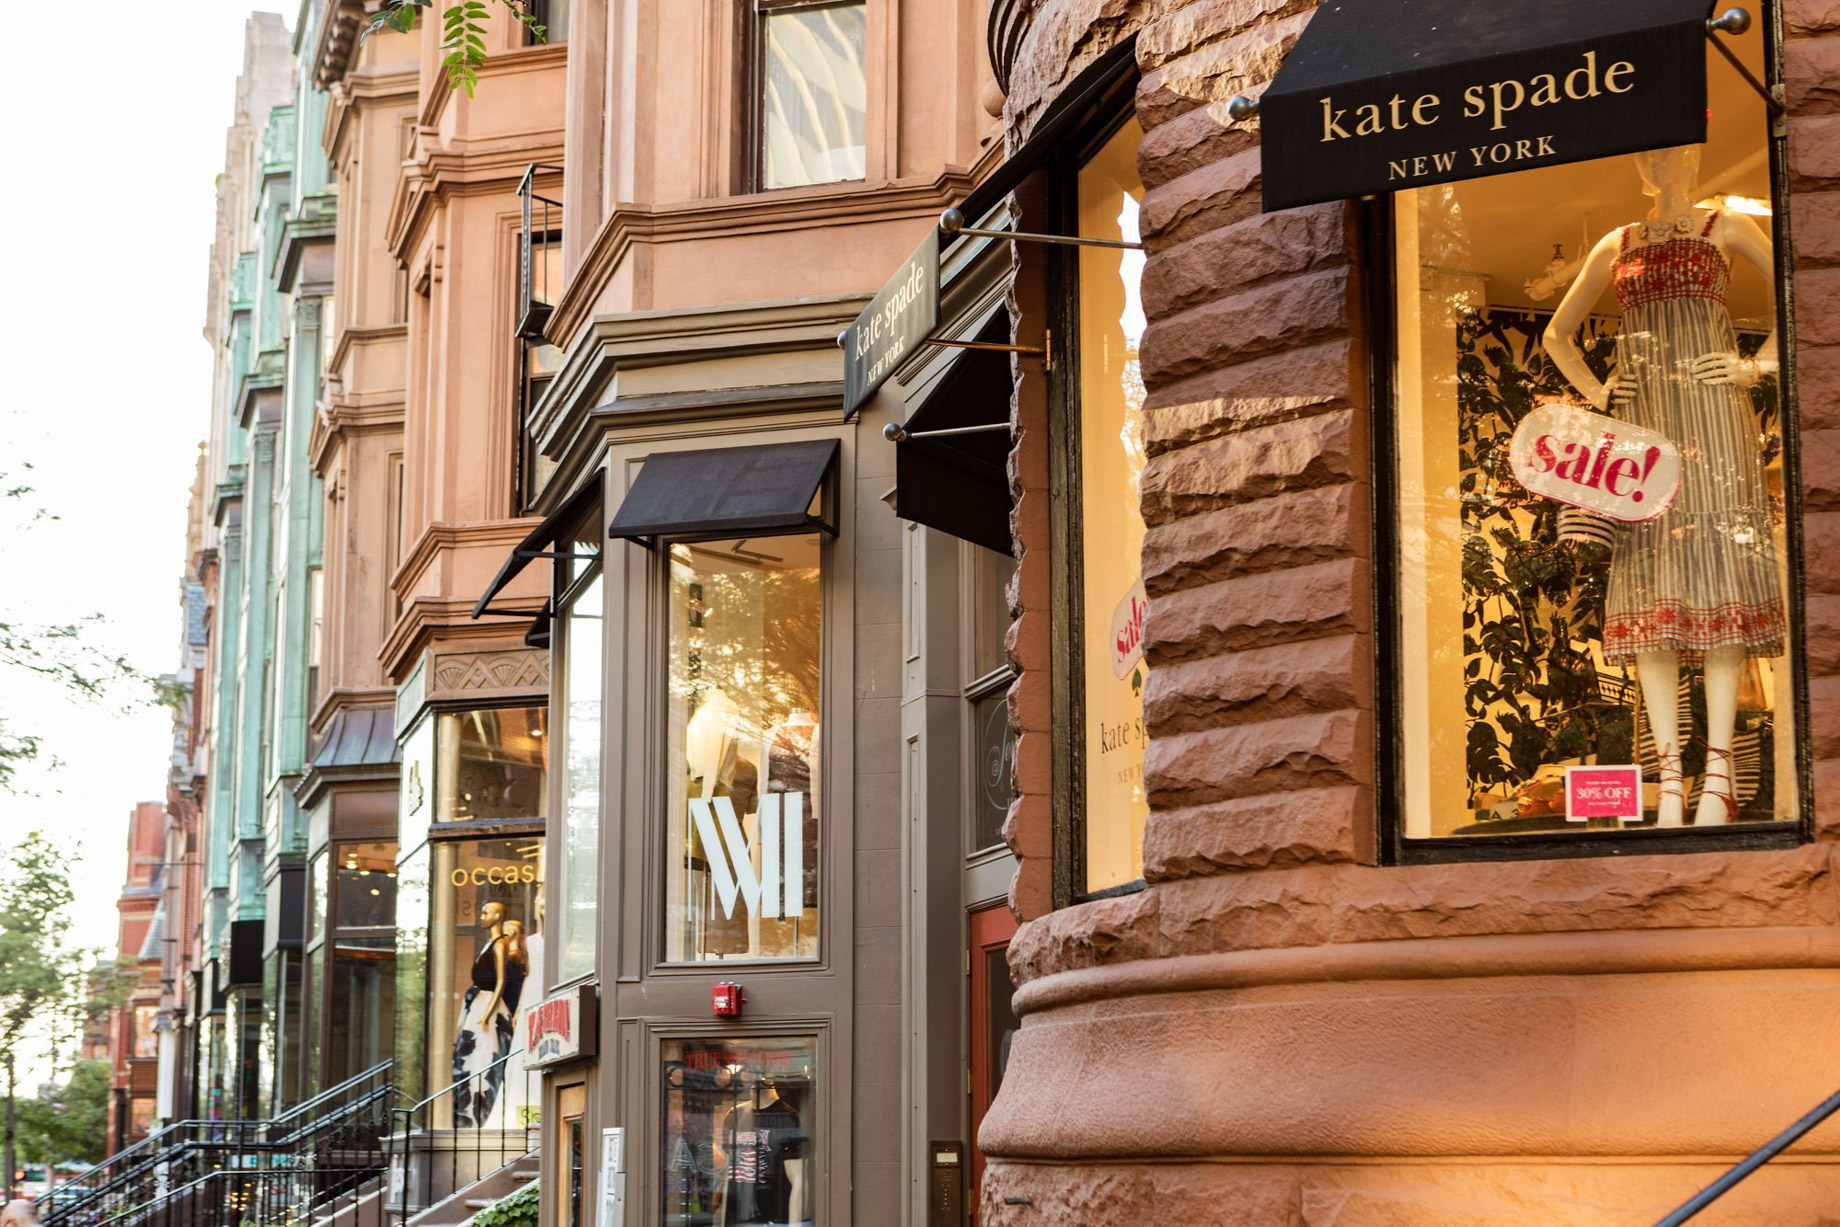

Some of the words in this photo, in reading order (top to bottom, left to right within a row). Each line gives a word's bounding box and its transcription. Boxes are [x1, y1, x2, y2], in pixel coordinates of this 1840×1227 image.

[1319, 92, 1441, 143] kate
[1463, 50, 1635, 131] spade
[1388, 151, 1458, 180] NEW
[1469, 135, 1557, 167] YORK
[854, 312, 882, 361] kate
[884, 261, 924, 337] spade
[867, 357, 884, 386] NEW
[884, 335, 905, 368] YORK
[1528, 431, 1661, 503] sale!
[1116, 593, 1149, 663] sale
[1100, 722, 1130, 754] kate
[1576, 786, 1602, 799] 30%
[1604, 786, 1632, 799] OFF
